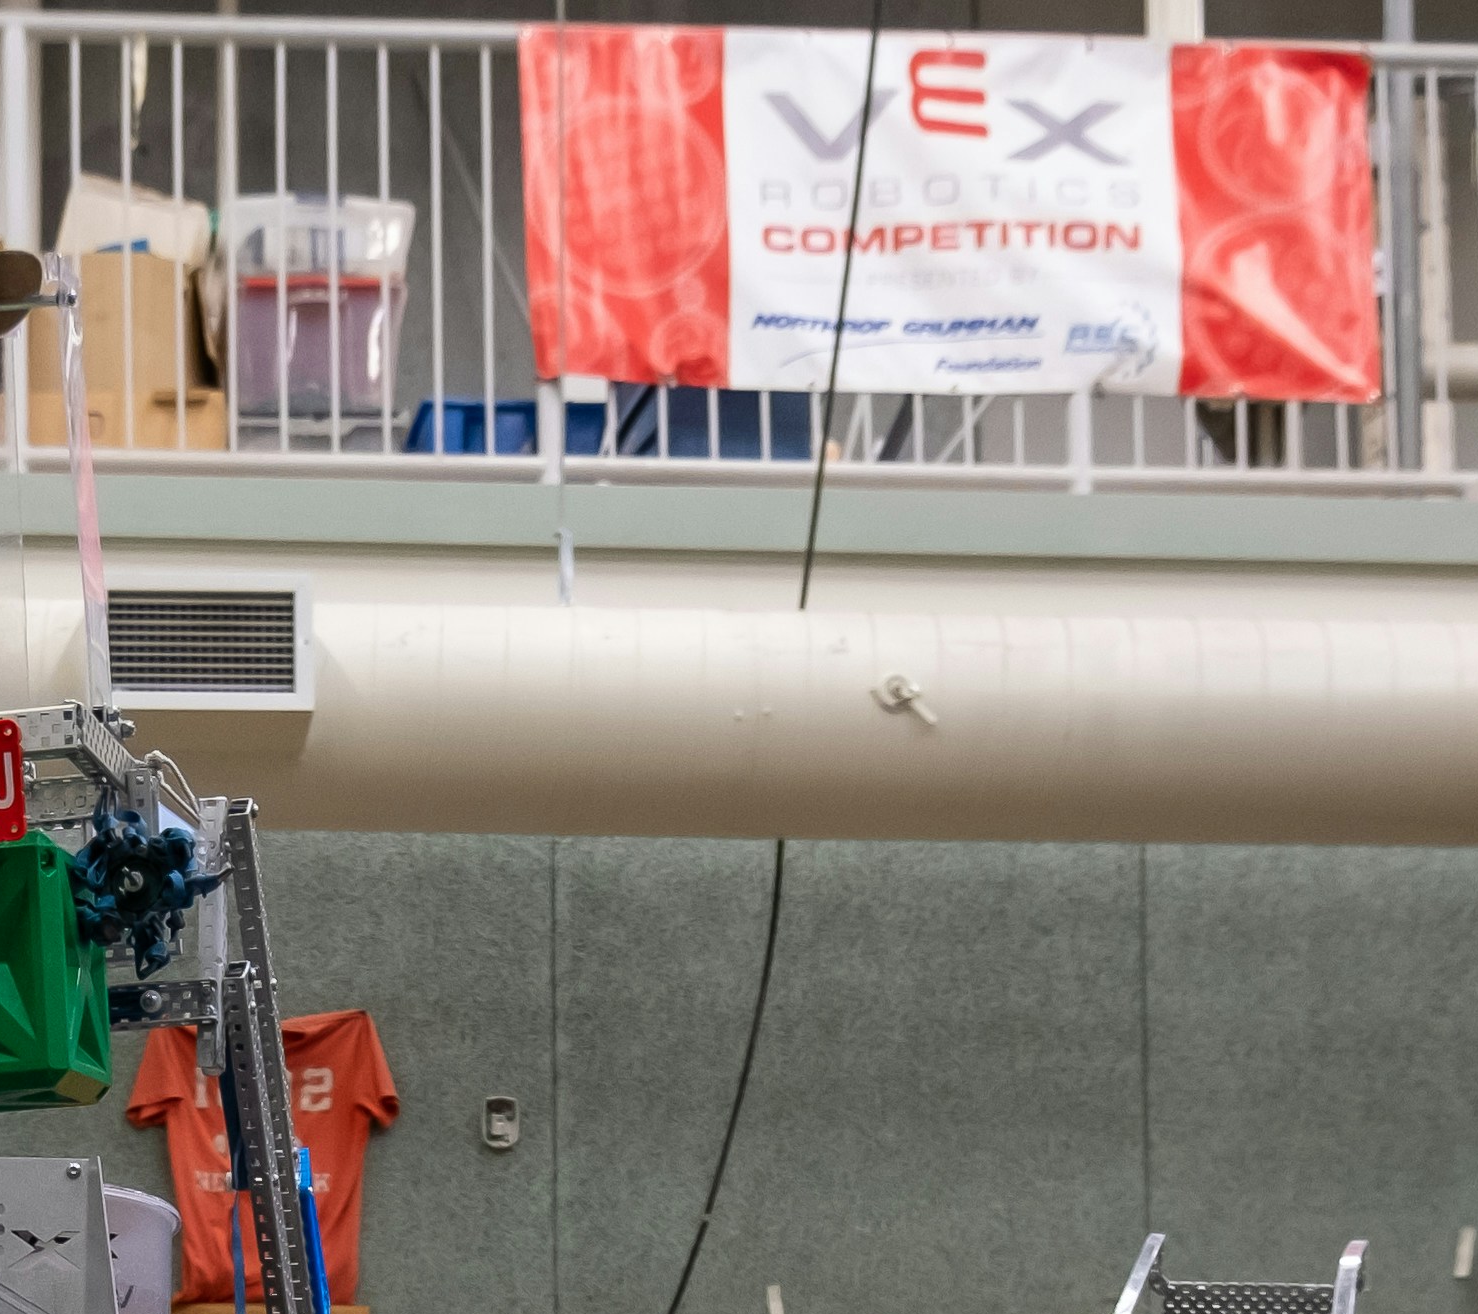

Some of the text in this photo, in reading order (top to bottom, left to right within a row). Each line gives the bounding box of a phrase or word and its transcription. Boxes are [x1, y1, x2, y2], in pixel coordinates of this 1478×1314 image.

[762, 49, 1132, 166] VEX
[759, 174, 1140, 211] ROBOTICS
[761, 221, 1142, 255] COMPETITION
